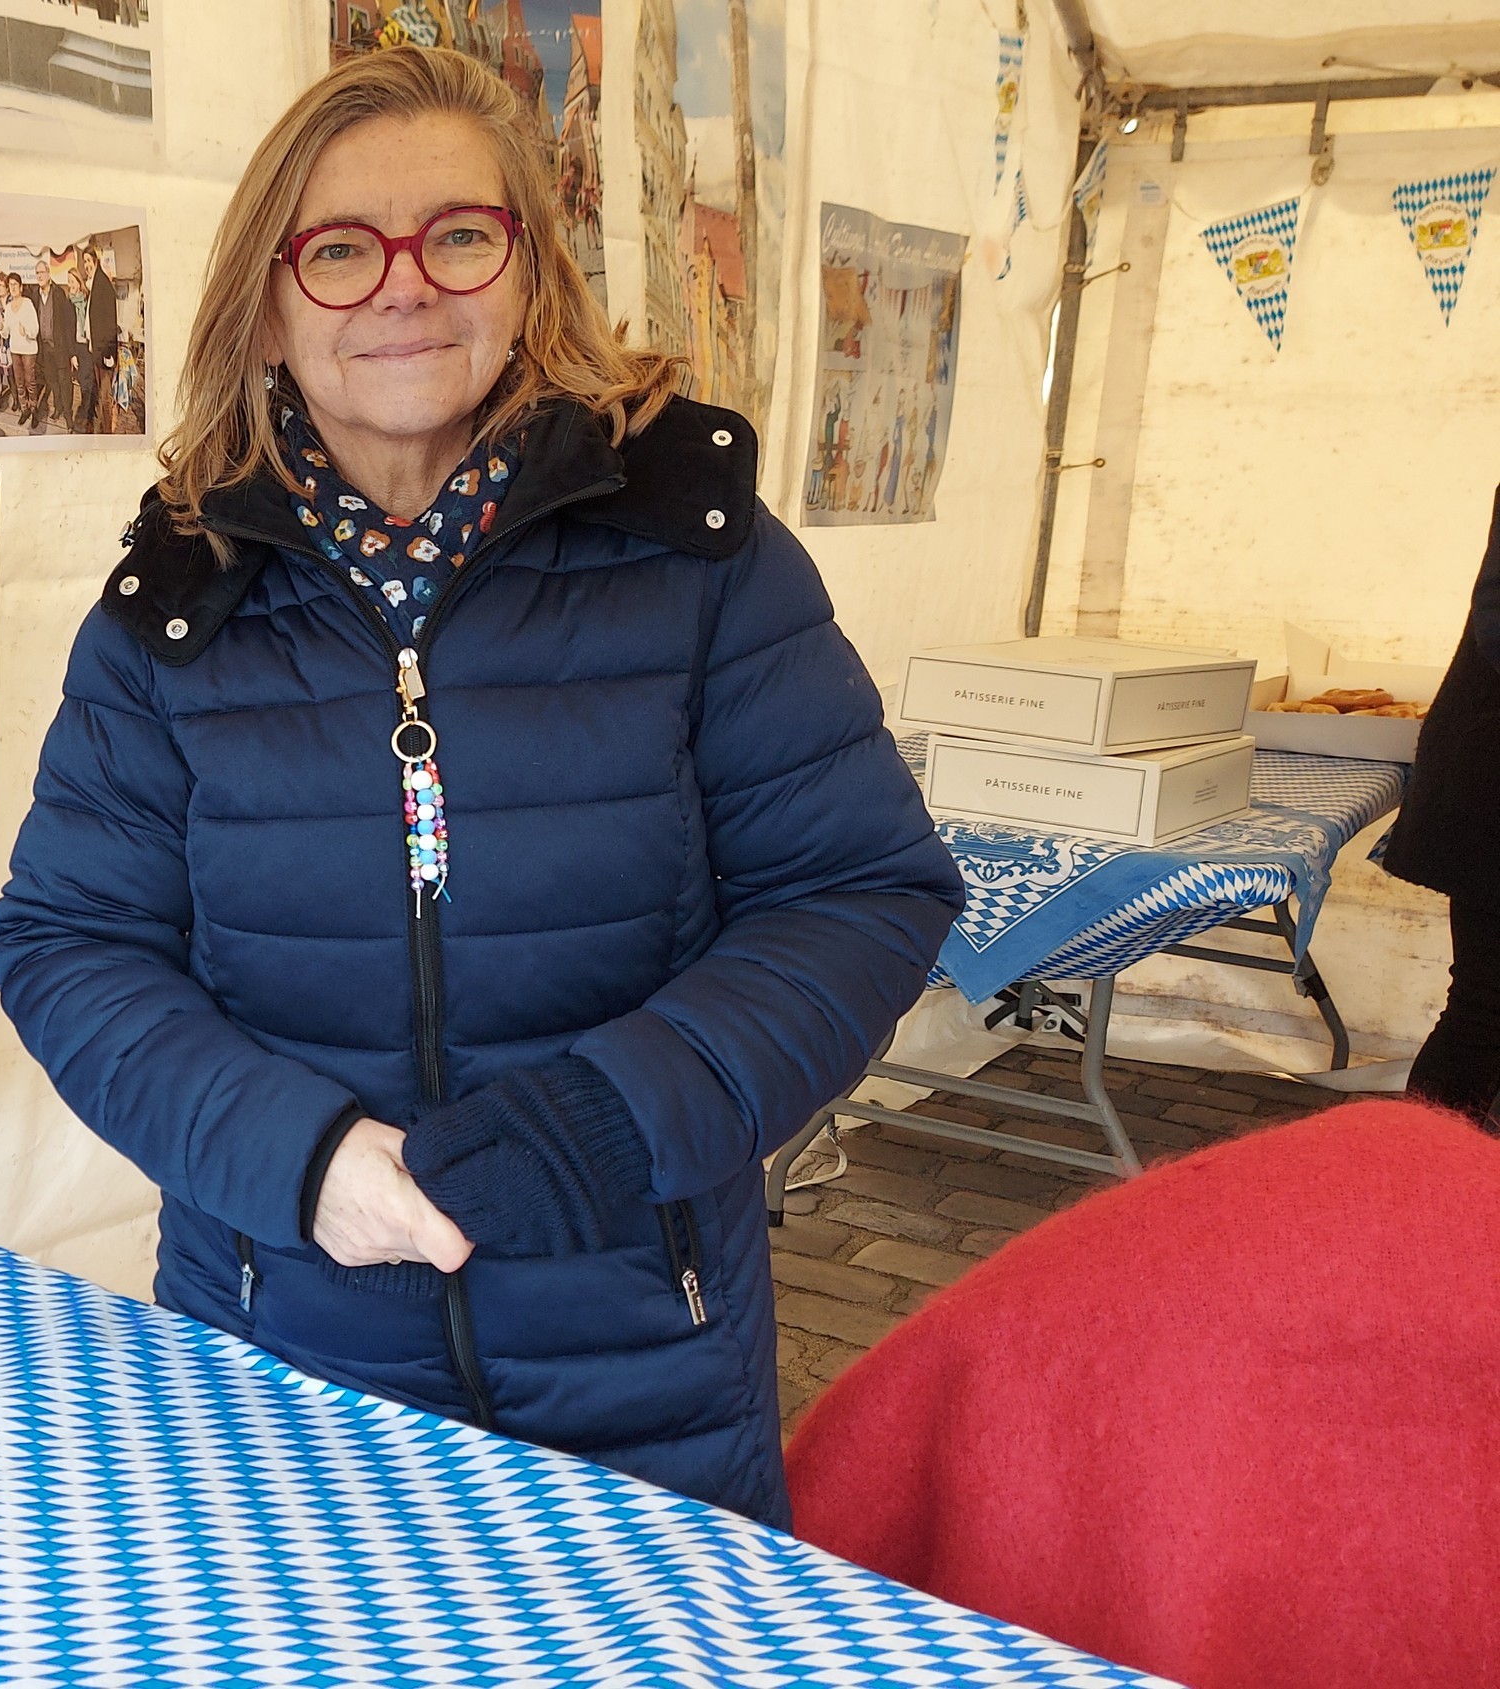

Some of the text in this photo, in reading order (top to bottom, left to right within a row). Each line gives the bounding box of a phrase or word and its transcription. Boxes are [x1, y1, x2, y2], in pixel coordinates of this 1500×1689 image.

[954, 689, 1045, 709] PÂTISSERIE FINE
[985, 778, 1083, 800] PÂTISSERIE FINE
